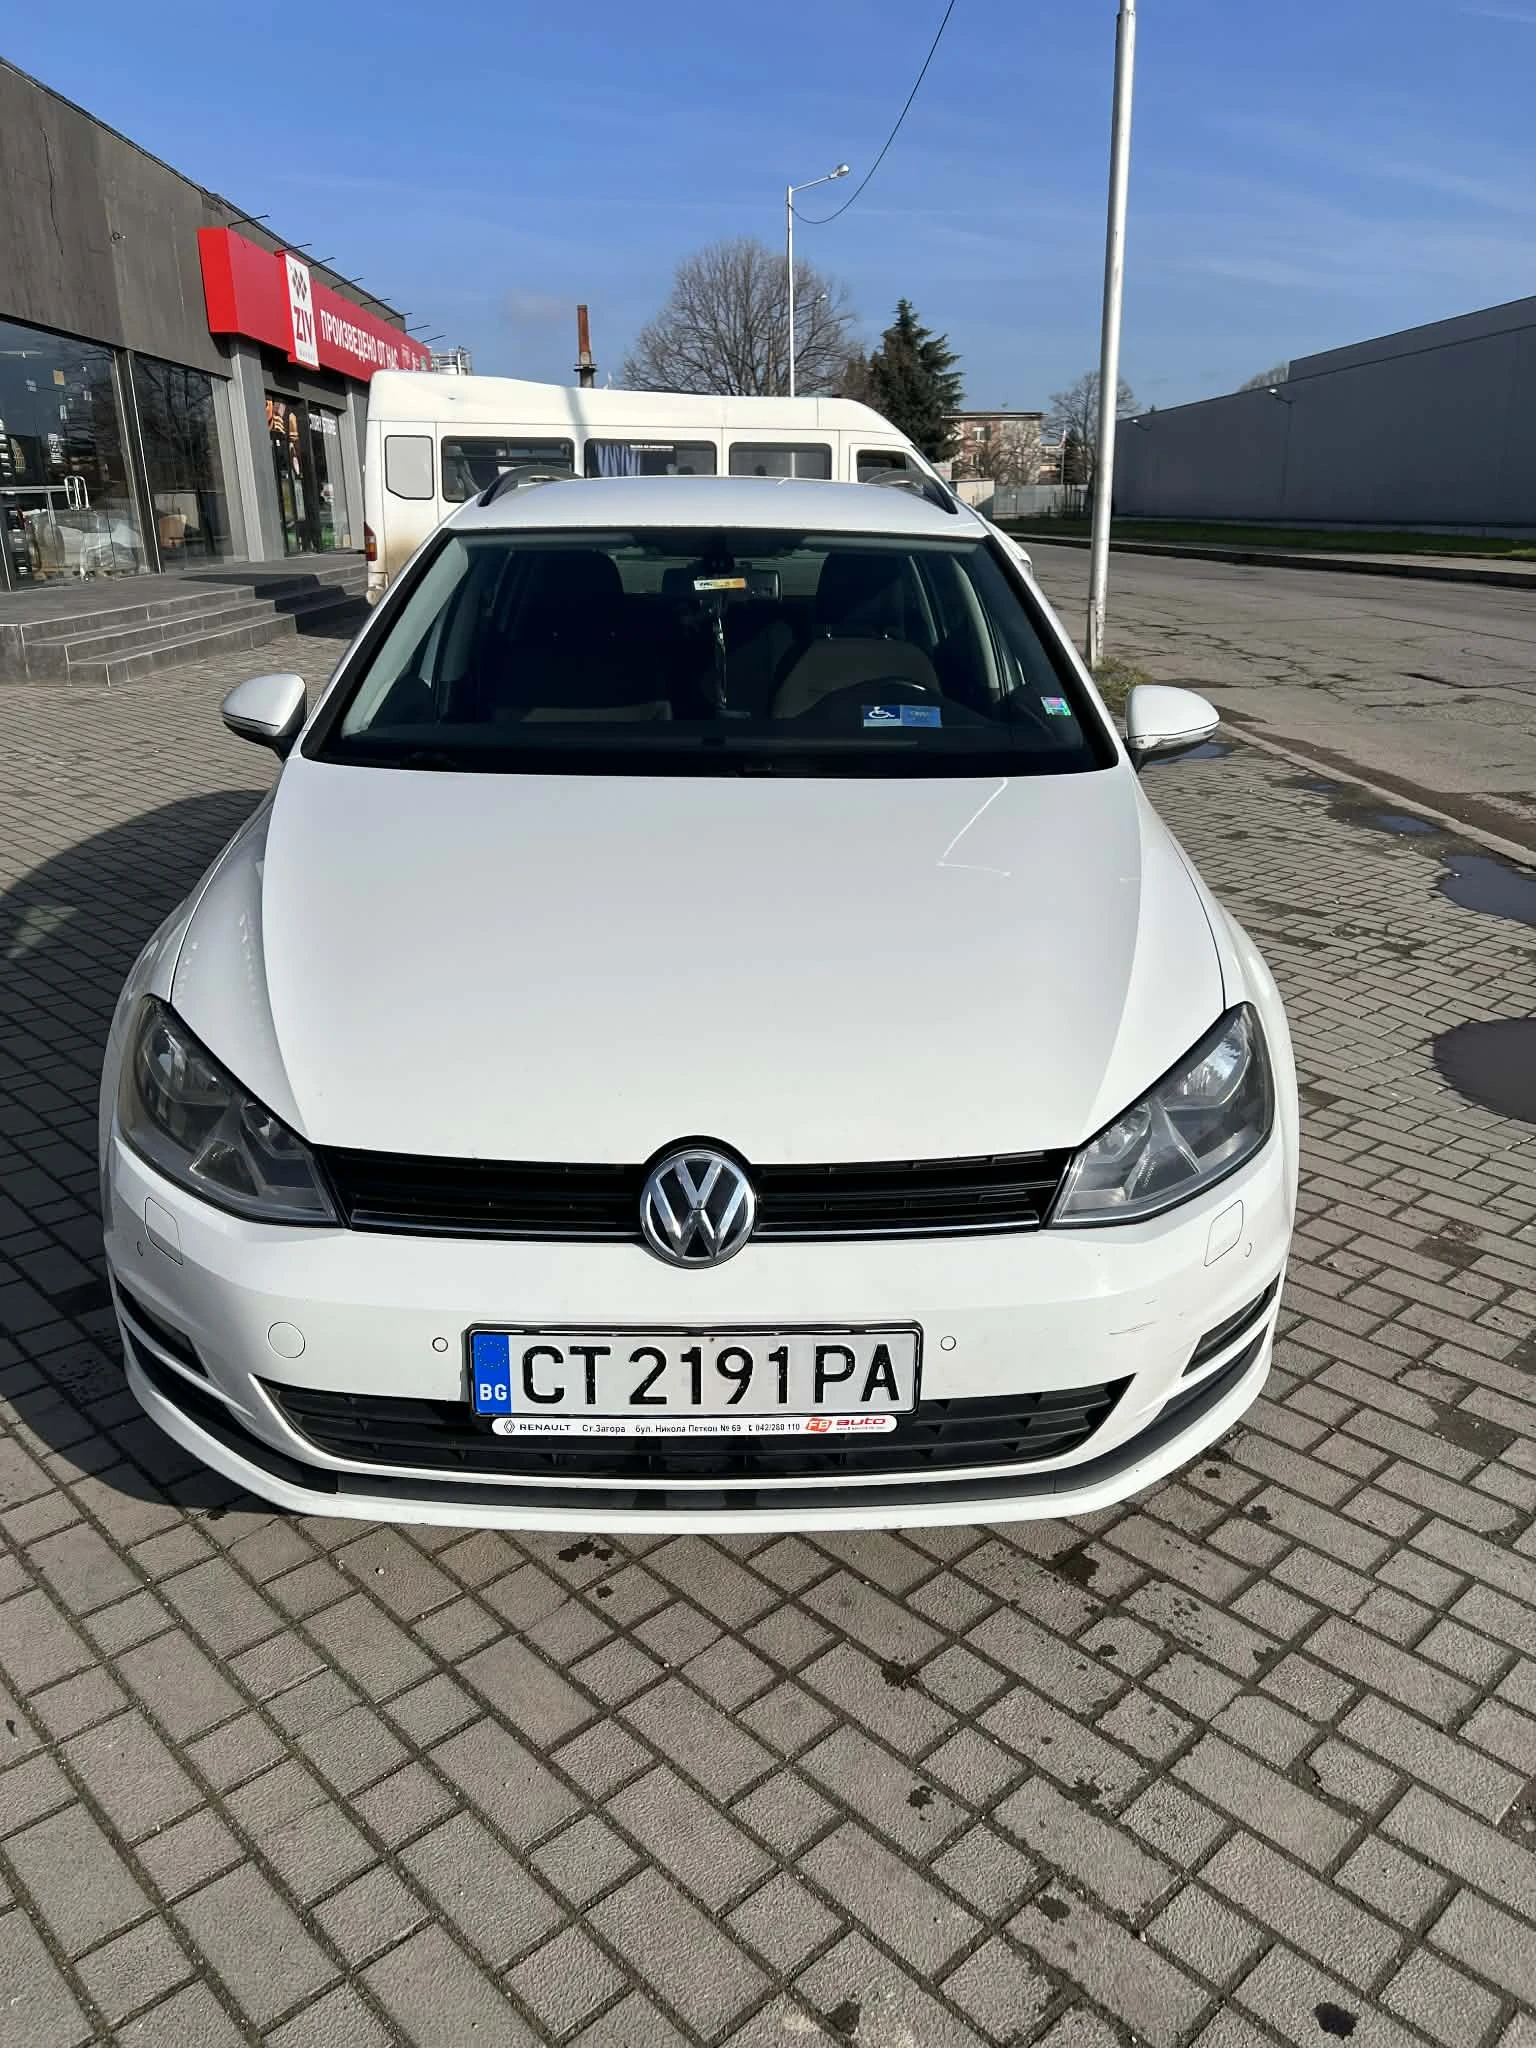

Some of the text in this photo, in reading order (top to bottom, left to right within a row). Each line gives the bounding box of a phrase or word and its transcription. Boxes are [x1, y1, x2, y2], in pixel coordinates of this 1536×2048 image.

[293, 305, 313, 345] ZIV
[320, 309, 377, 364] ПРОИЗВЕДЕНО
[522, 1343, 900, 1405] CT 2191 PA
[479, 1383, 508, 1401] BG
[519, 1423, 571, 1431] RENAULT
[655, 1424, 686, 1433] Никола
[836, 1417, 886, 1425] auto
